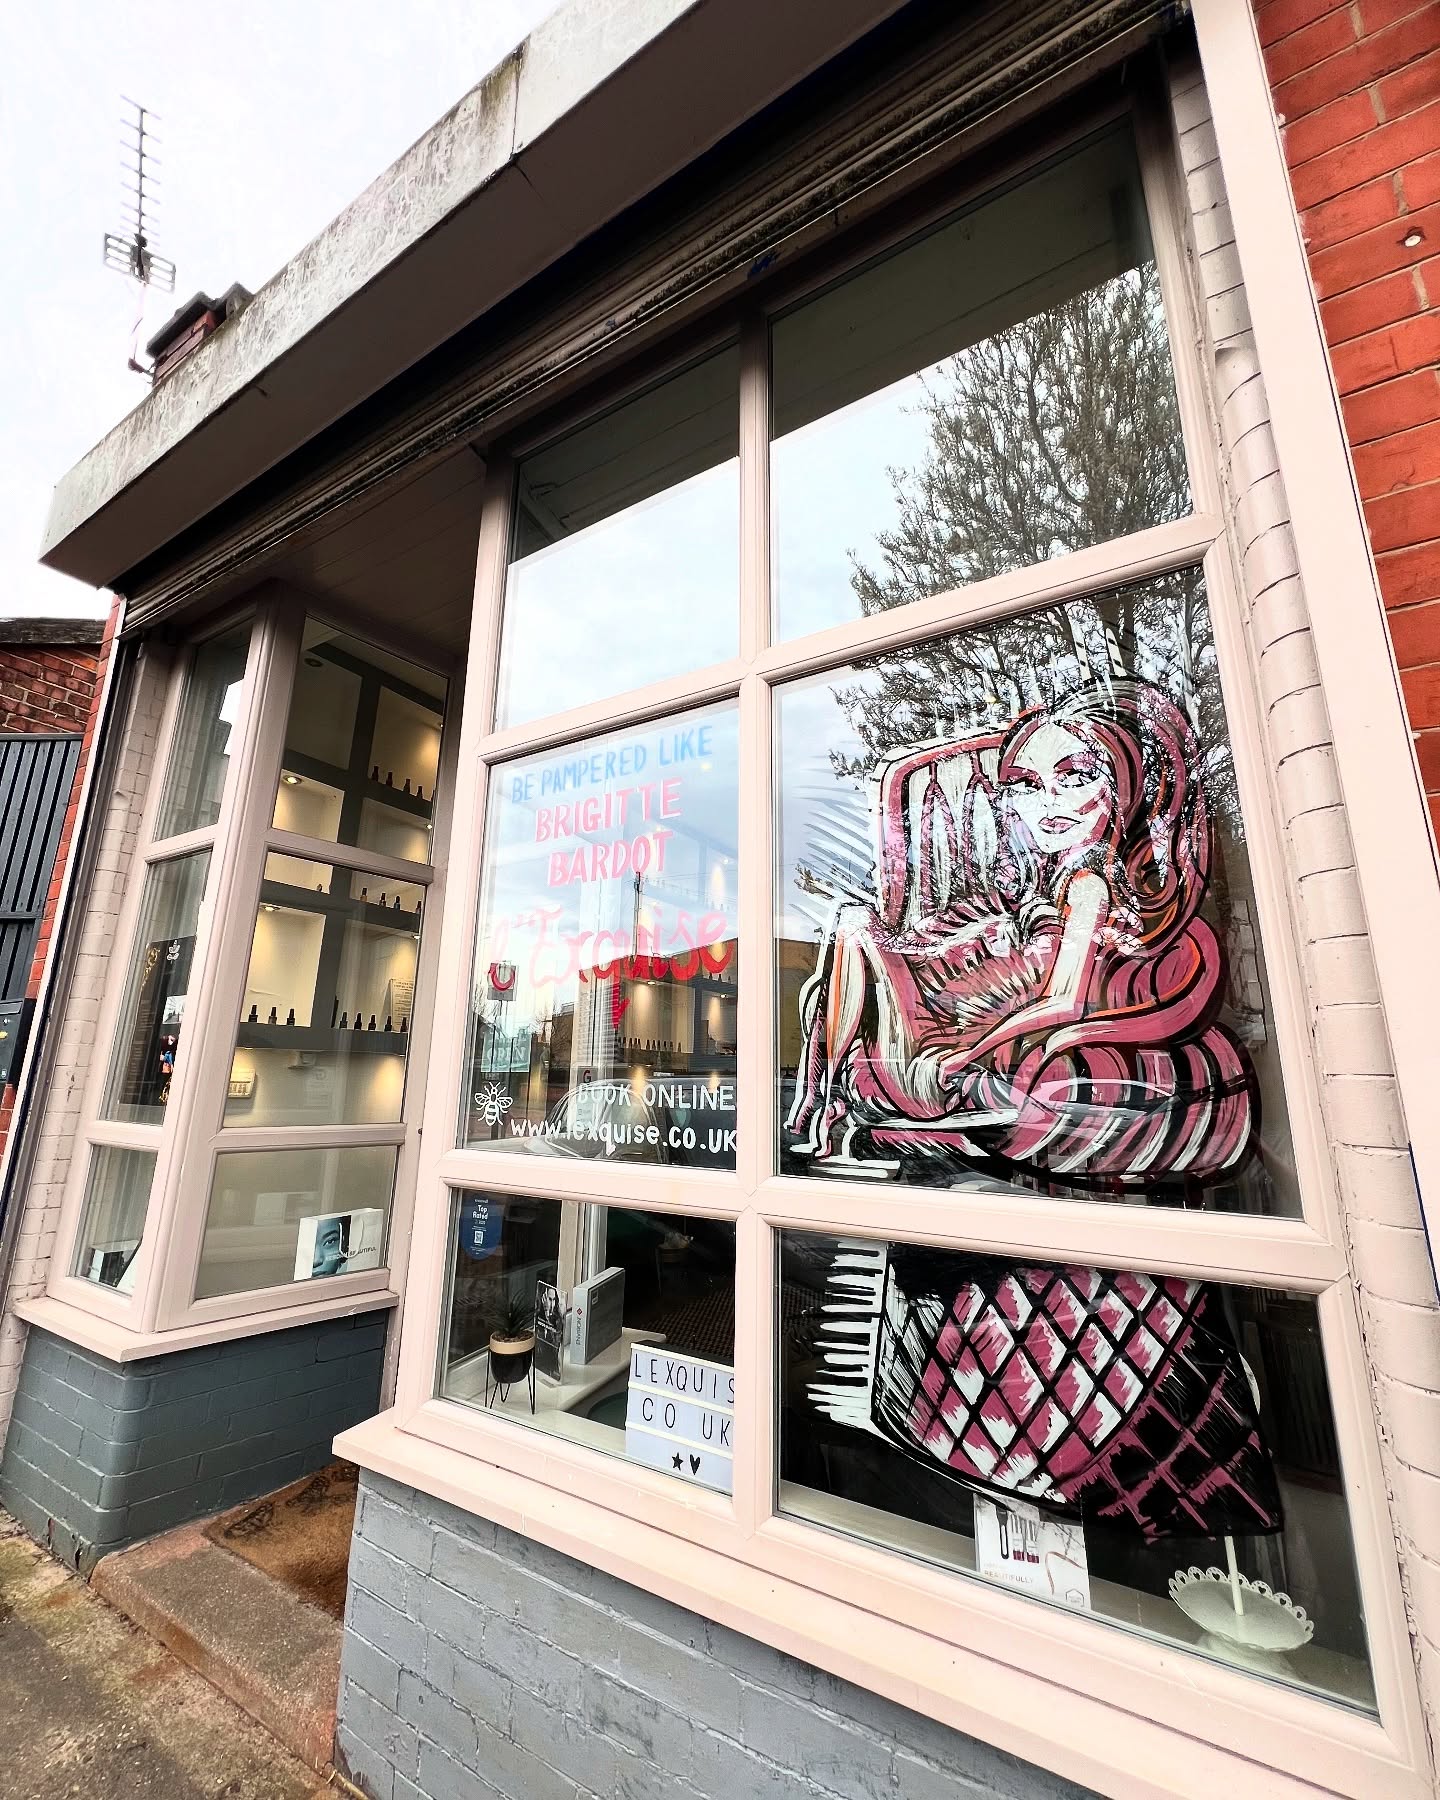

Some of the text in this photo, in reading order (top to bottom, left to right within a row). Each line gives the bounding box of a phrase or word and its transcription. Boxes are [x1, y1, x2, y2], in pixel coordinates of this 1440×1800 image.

[512, 725, 713, 803] BE PAMPERED LIKE
[535, 776, 683, 842] BRIGITTE
[547, 830, 674, 887] BARDOT
[577, 1083, 736, 1111] BOOK ONLINE
[477, 1204, 488, 1214] Top
[642, 1397, 731, 1447] CO UK
